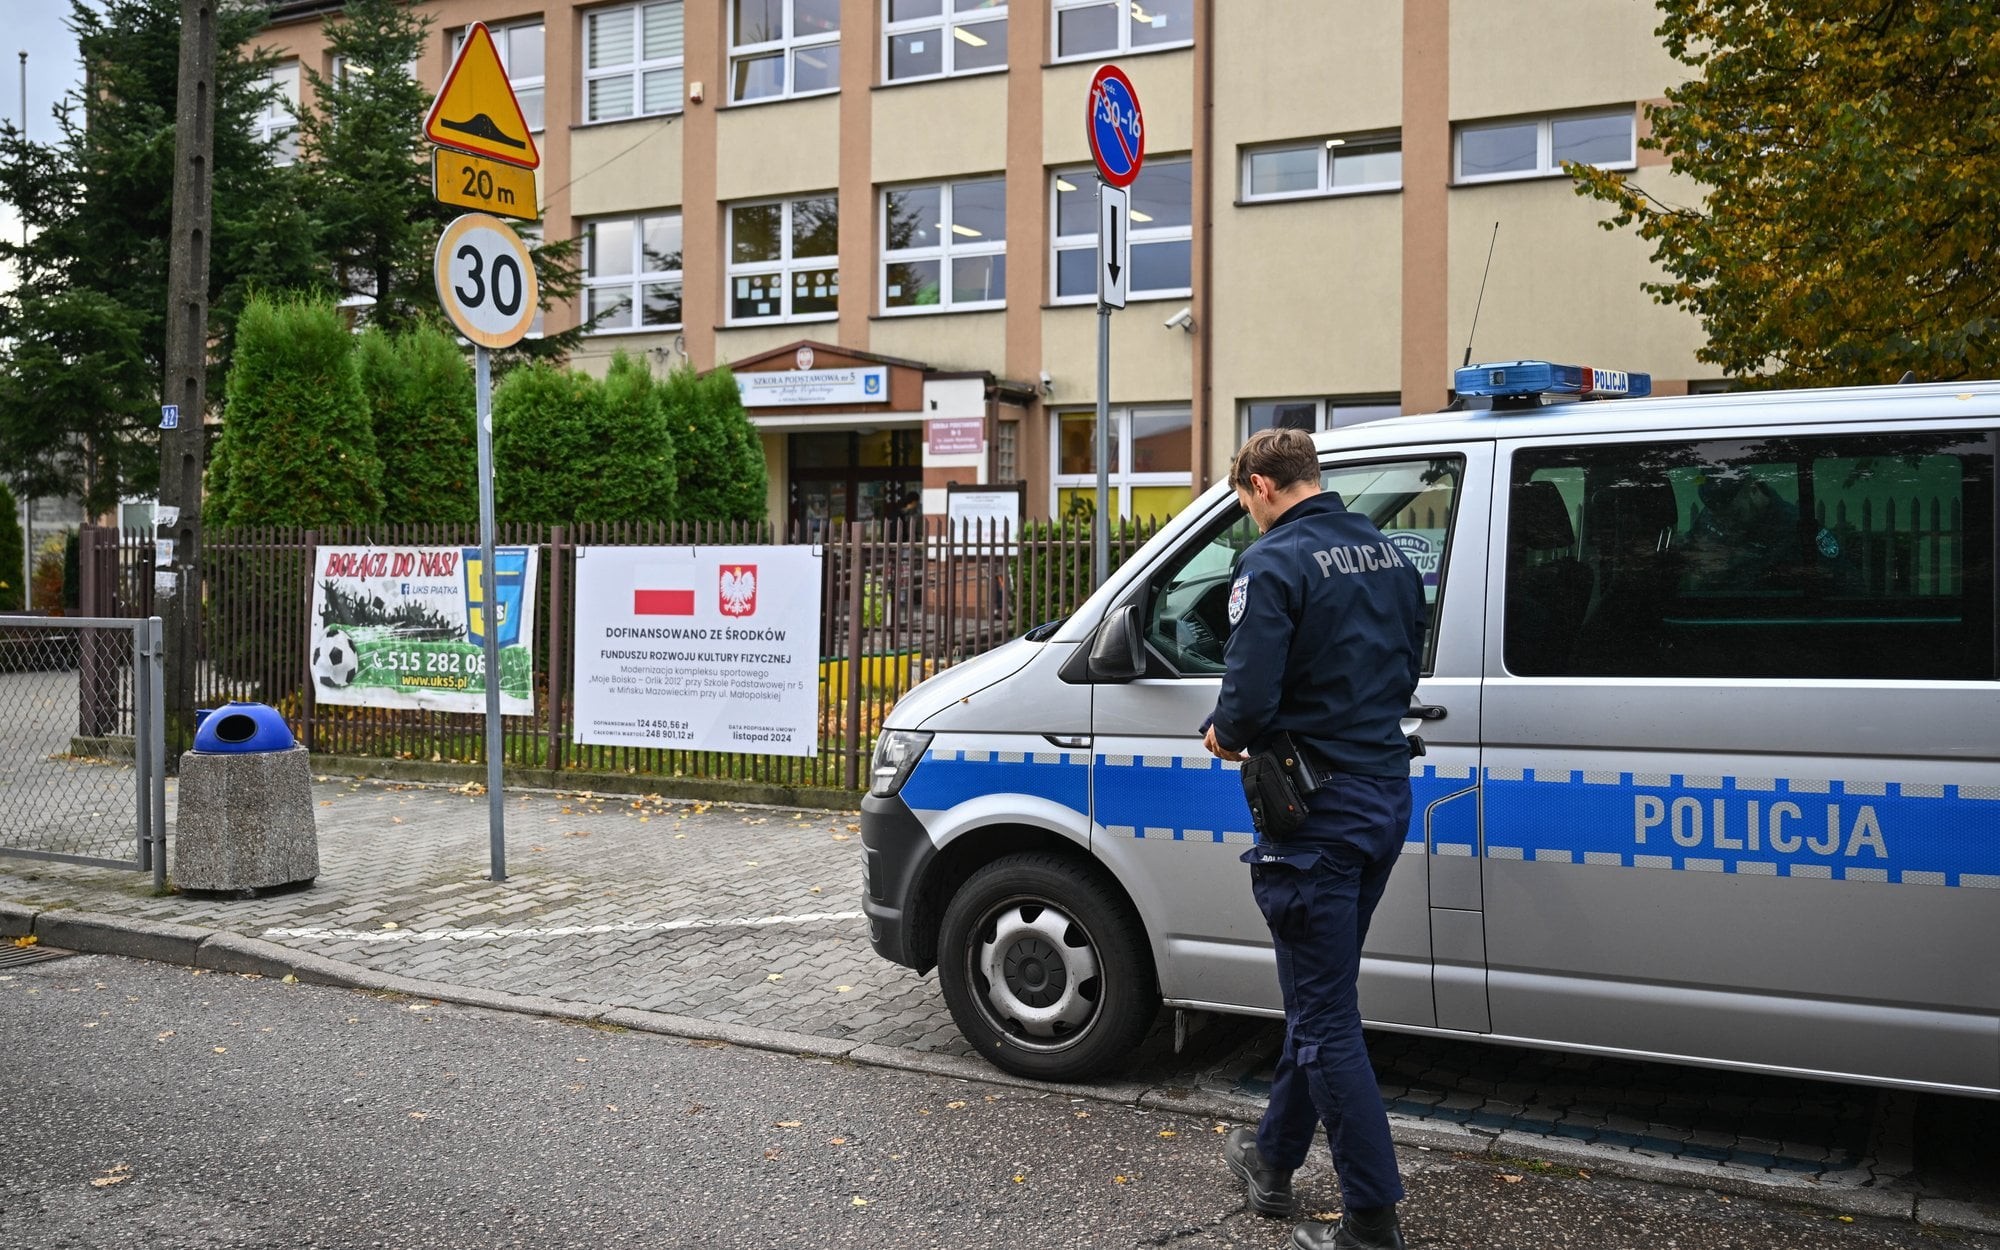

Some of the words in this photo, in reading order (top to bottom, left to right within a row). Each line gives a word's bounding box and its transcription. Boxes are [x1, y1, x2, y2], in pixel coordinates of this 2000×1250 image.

[462, 166, 493, 200] 20
[497, 185, 515, 205] m
[455, 244, 522, 316] 30
[753, 376, 784, 385] SZKOŁA
[785, 374, 840, 385] PODSTAWOWA
[850, 372, 856, 381] 5
[1594, 370, 1627, 391] POLICJA
[1393, 537, 1427, 552] HRONA
[390, 552, 415, 577] DO
[417, 551, 459, 577] NAS!
[1312, 541, 1405, 579] POLICJA
[412, 586, 429, 595] UKS
[606, 627, 707, 640] DOFINANSOWANO
[710, 629, 723, 640] ZE
[725, 626, 786, 641] ŚRODKÓW
[388, 651, 420, 671] 515
[427, 652, 460, 673] 282
[465, 654, 486, 674] 08
[600, 650, 648, 660] FUNDUSZU
[649, 651, 696, 661] ROZWOJU
[697, 652, 739, 662] KULTURY
[741, 653, 792, 664] FIZYCZNEJ
[621, 665, 673, 676] Modernizacja
[674, 666, 718, 677] kompleksu
[720, 669, 769, 680] sportowego
[402, 675, 467, 688] www.uks5.pl
[611, 675, 637, 684] Boisko
[645, 676, 662, 685] Orlik
[685, 678, 702, 688] przy
[704, 678, 729, 687] Szkole
[730, 679, 786, 692] Podstawowej
[798, 681, 804, 690] 5
[617, 686, 644, 695] Mińsku
[645, 687, 698, 697] Mazowieckim
[700, 690, 717, 699] przy
[730, 690, 781, 703] Małopolskiej
[637, 719, 650, 728] 124
[652, 720, 680, 730] 450,56
[681, 721, 689, 730] zł
[646, 729, 661, 738] 248
[662, 730, 686, 740] 901,12
[687, 731, 694, 740] zł
[733, 731, 769, 743] listopad
[770, 733, 792, 742] 2024
[1634, 794, 1889, 859] POLICJA
